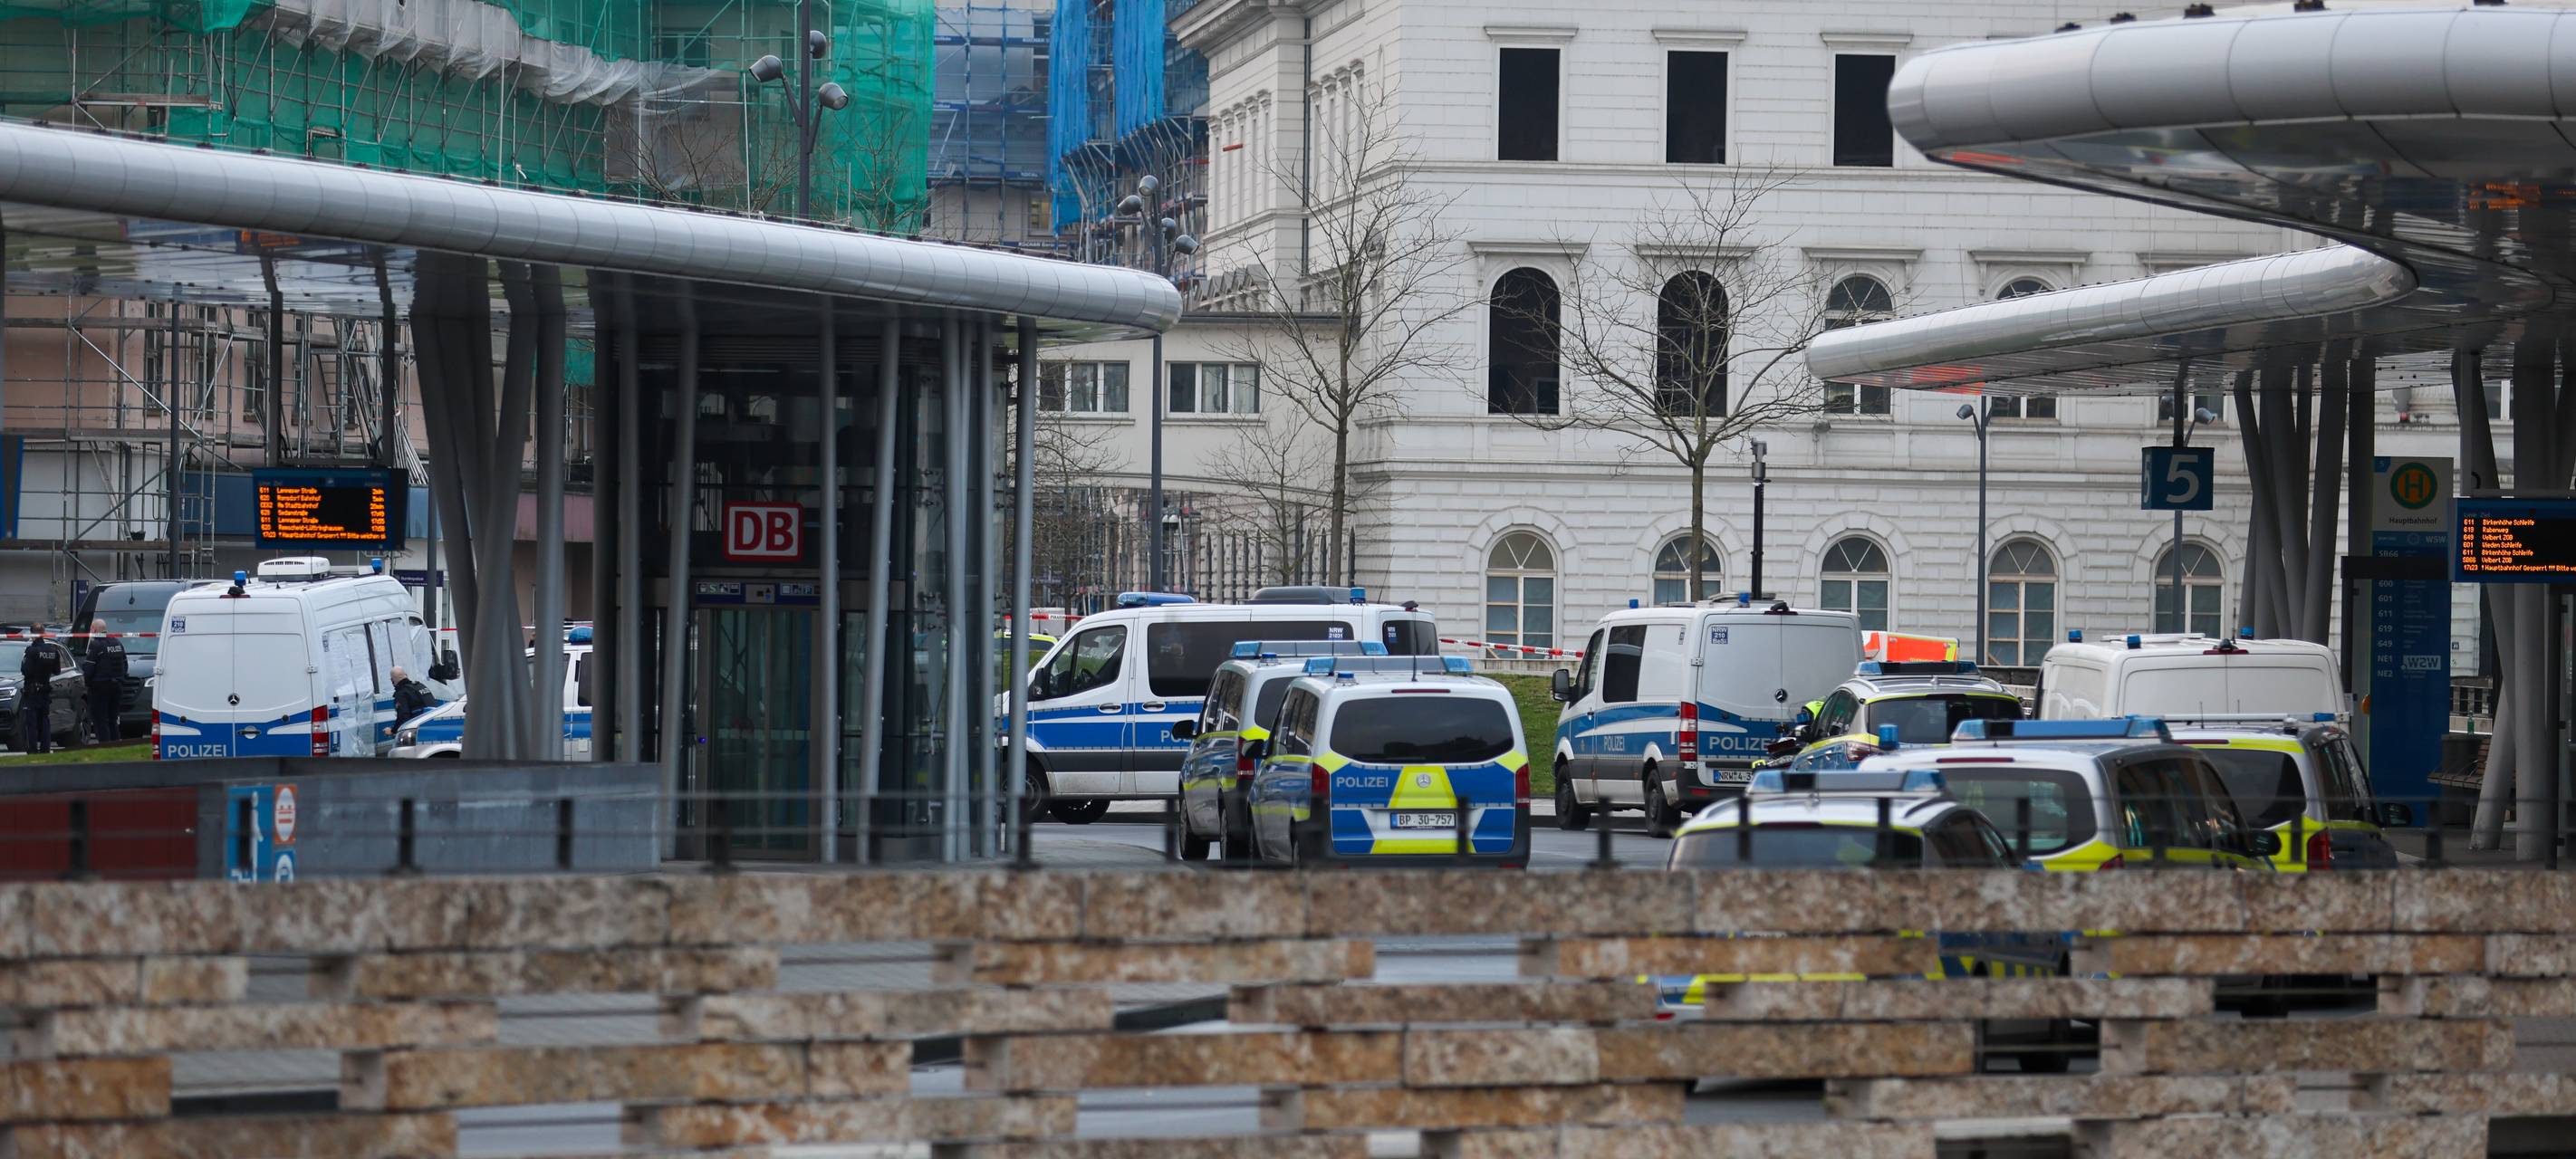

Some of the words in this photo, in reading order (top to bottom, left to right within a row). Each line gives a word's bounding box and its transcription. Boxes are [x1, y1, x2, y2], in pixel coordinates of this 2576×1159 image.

[2167, 455, 2199, 503] 5
[2405, 474, 2424, 498] H
[2389, 517, 2437, 525] Hauptbahnhof
[734, 511, 793, 551] DB
[168, 744, 226, 757] POLIZEI
[1604, 735, 1625, 752] POLIZEI
[1336, 777, 1389, 788] POLIZEI
[1399, 815, 1410, 825] BP
[1418, 815, 1452, 825] 30-757
